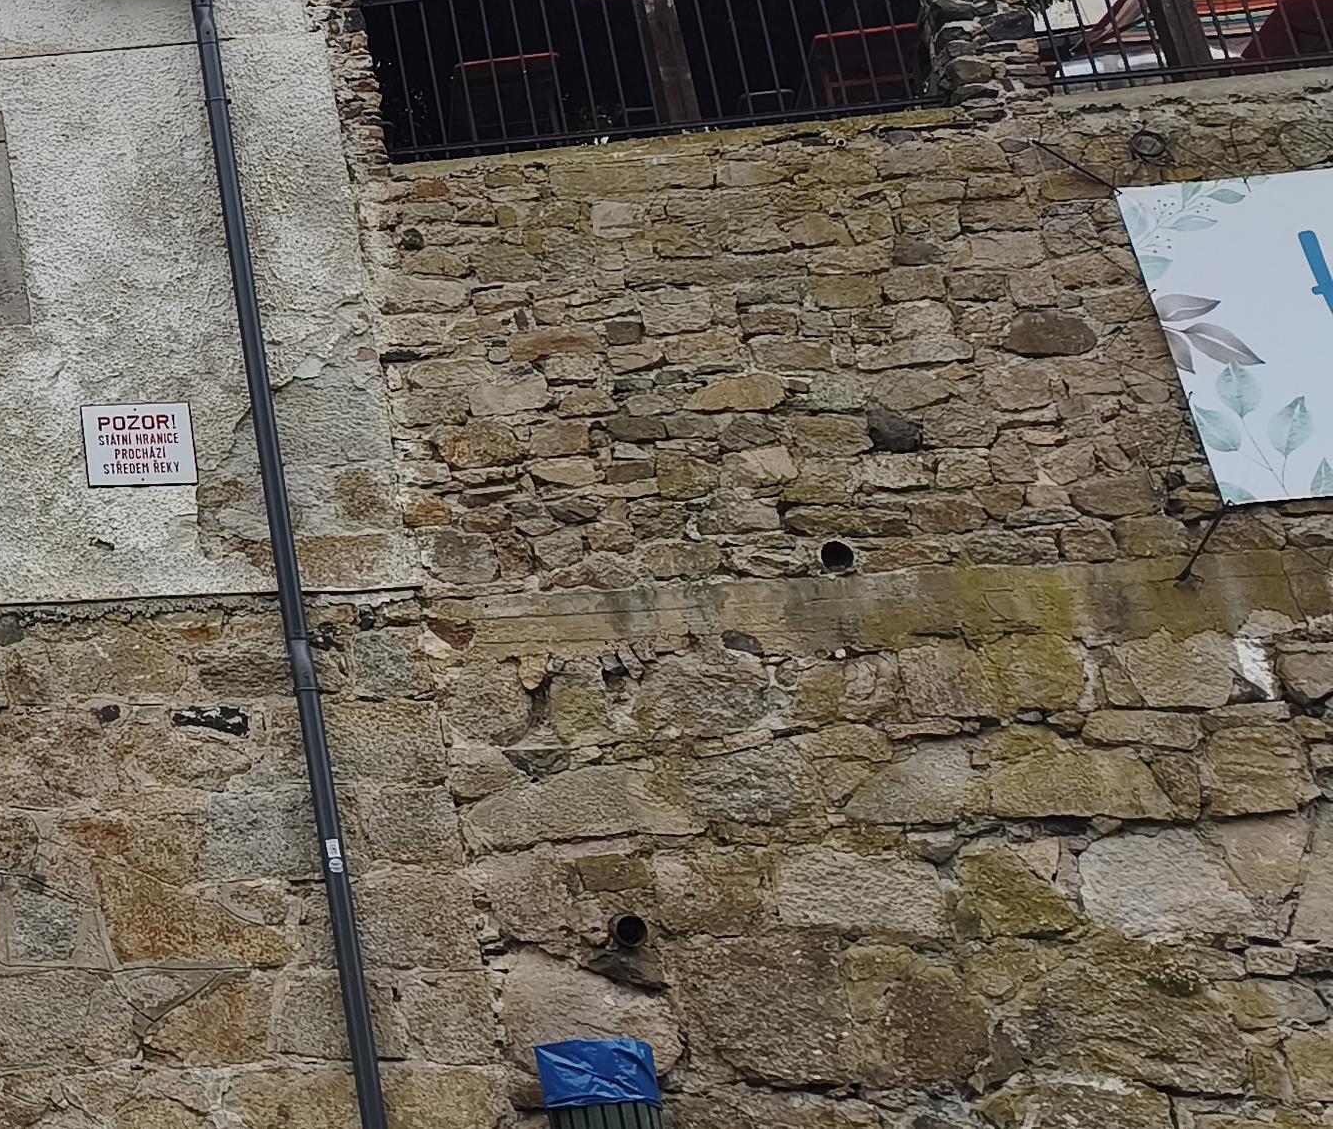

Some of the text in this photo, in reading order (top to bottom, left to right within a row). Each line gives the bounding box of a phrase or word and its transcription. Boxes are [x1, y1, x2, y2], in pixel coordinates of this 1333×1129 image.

[98, 414, 176, 431] POZOR!
[98, 433, 179, 446] STÁTNÍ HRANICE
[115, 446, 166, 459] PROCHÁZÍ
[103, 459, 179, 474] STŘEDEM ŘEKY
